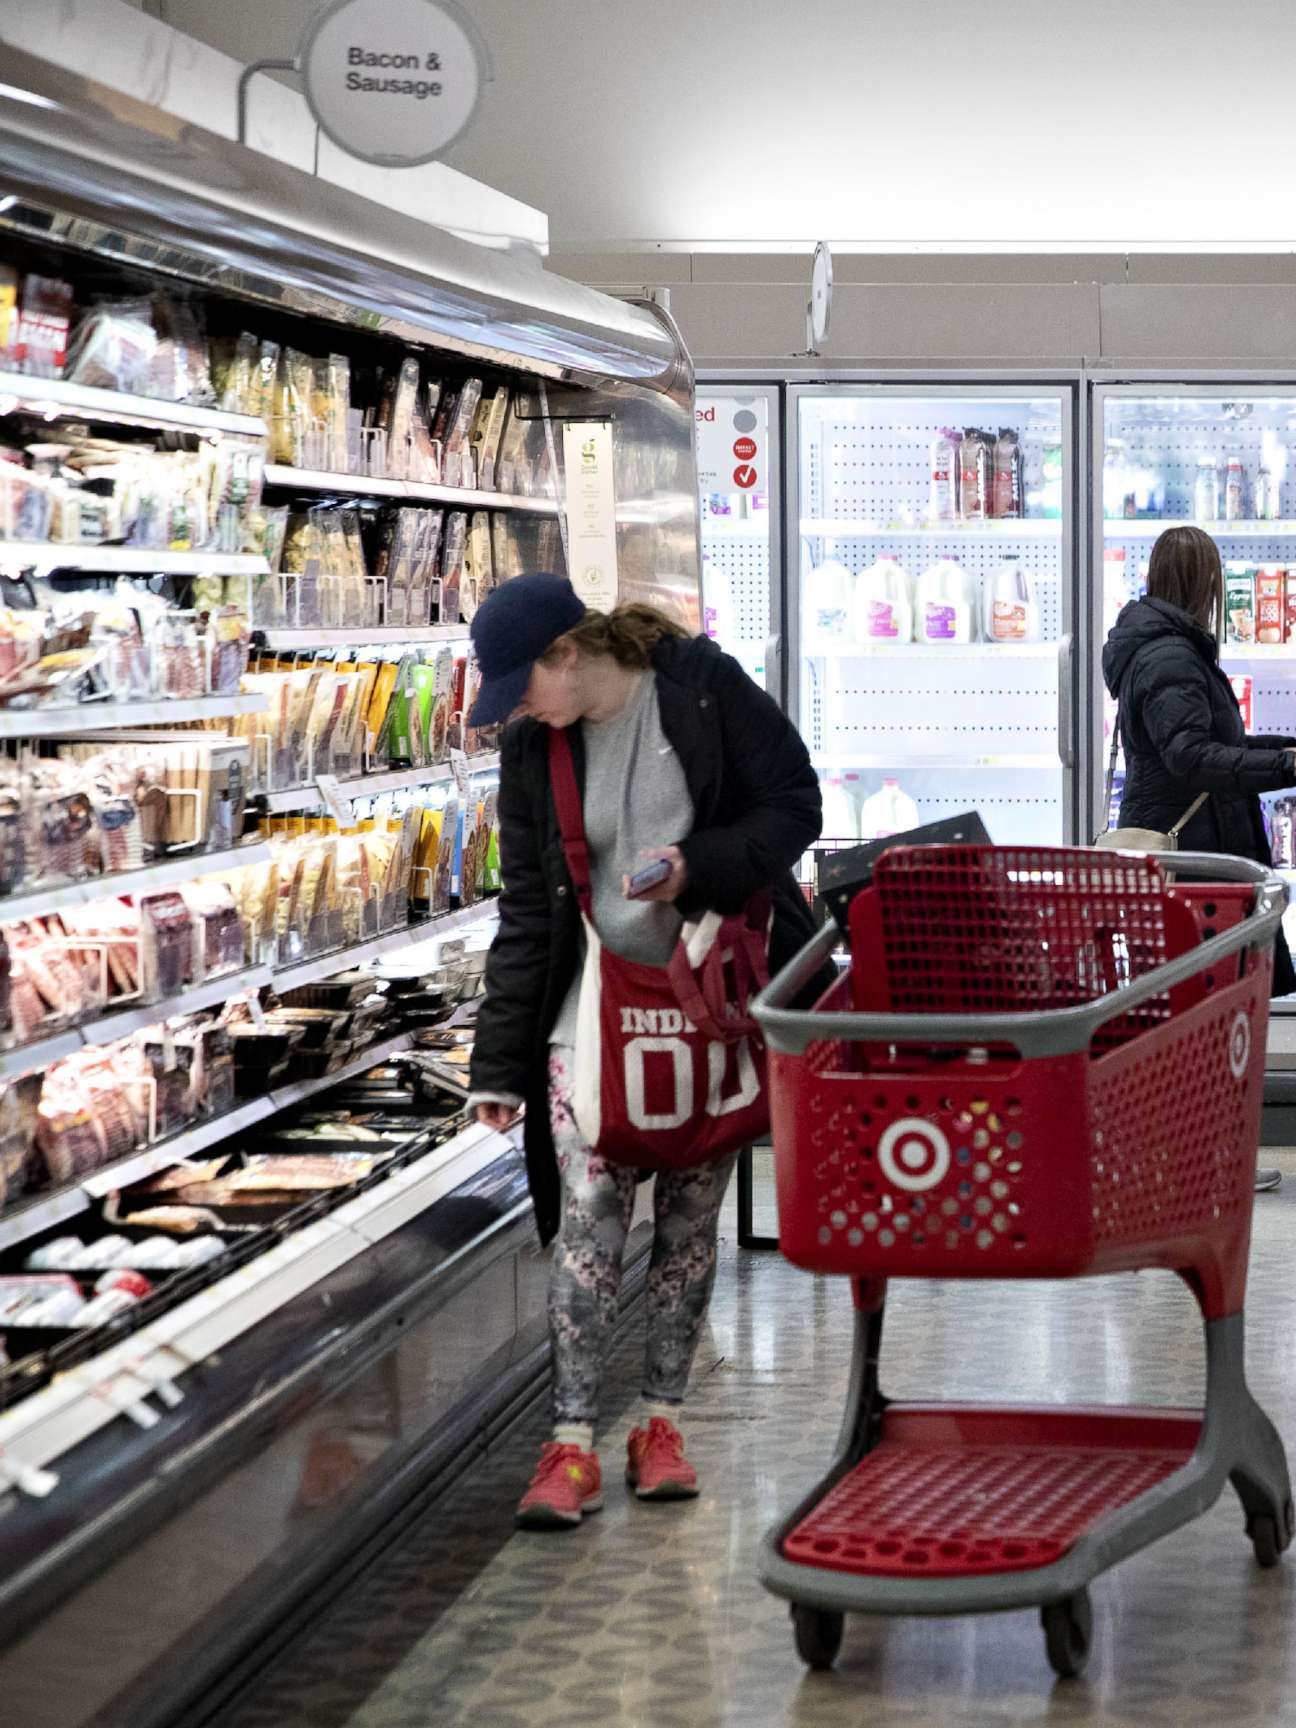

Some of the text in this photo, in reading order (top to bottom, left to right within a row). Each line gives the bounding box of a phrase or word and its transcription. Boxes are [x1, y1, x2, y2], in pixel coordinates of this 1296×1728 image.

[348, 47, 442, 71] Bacon &
[346, 72, 441, 99] Sausage
